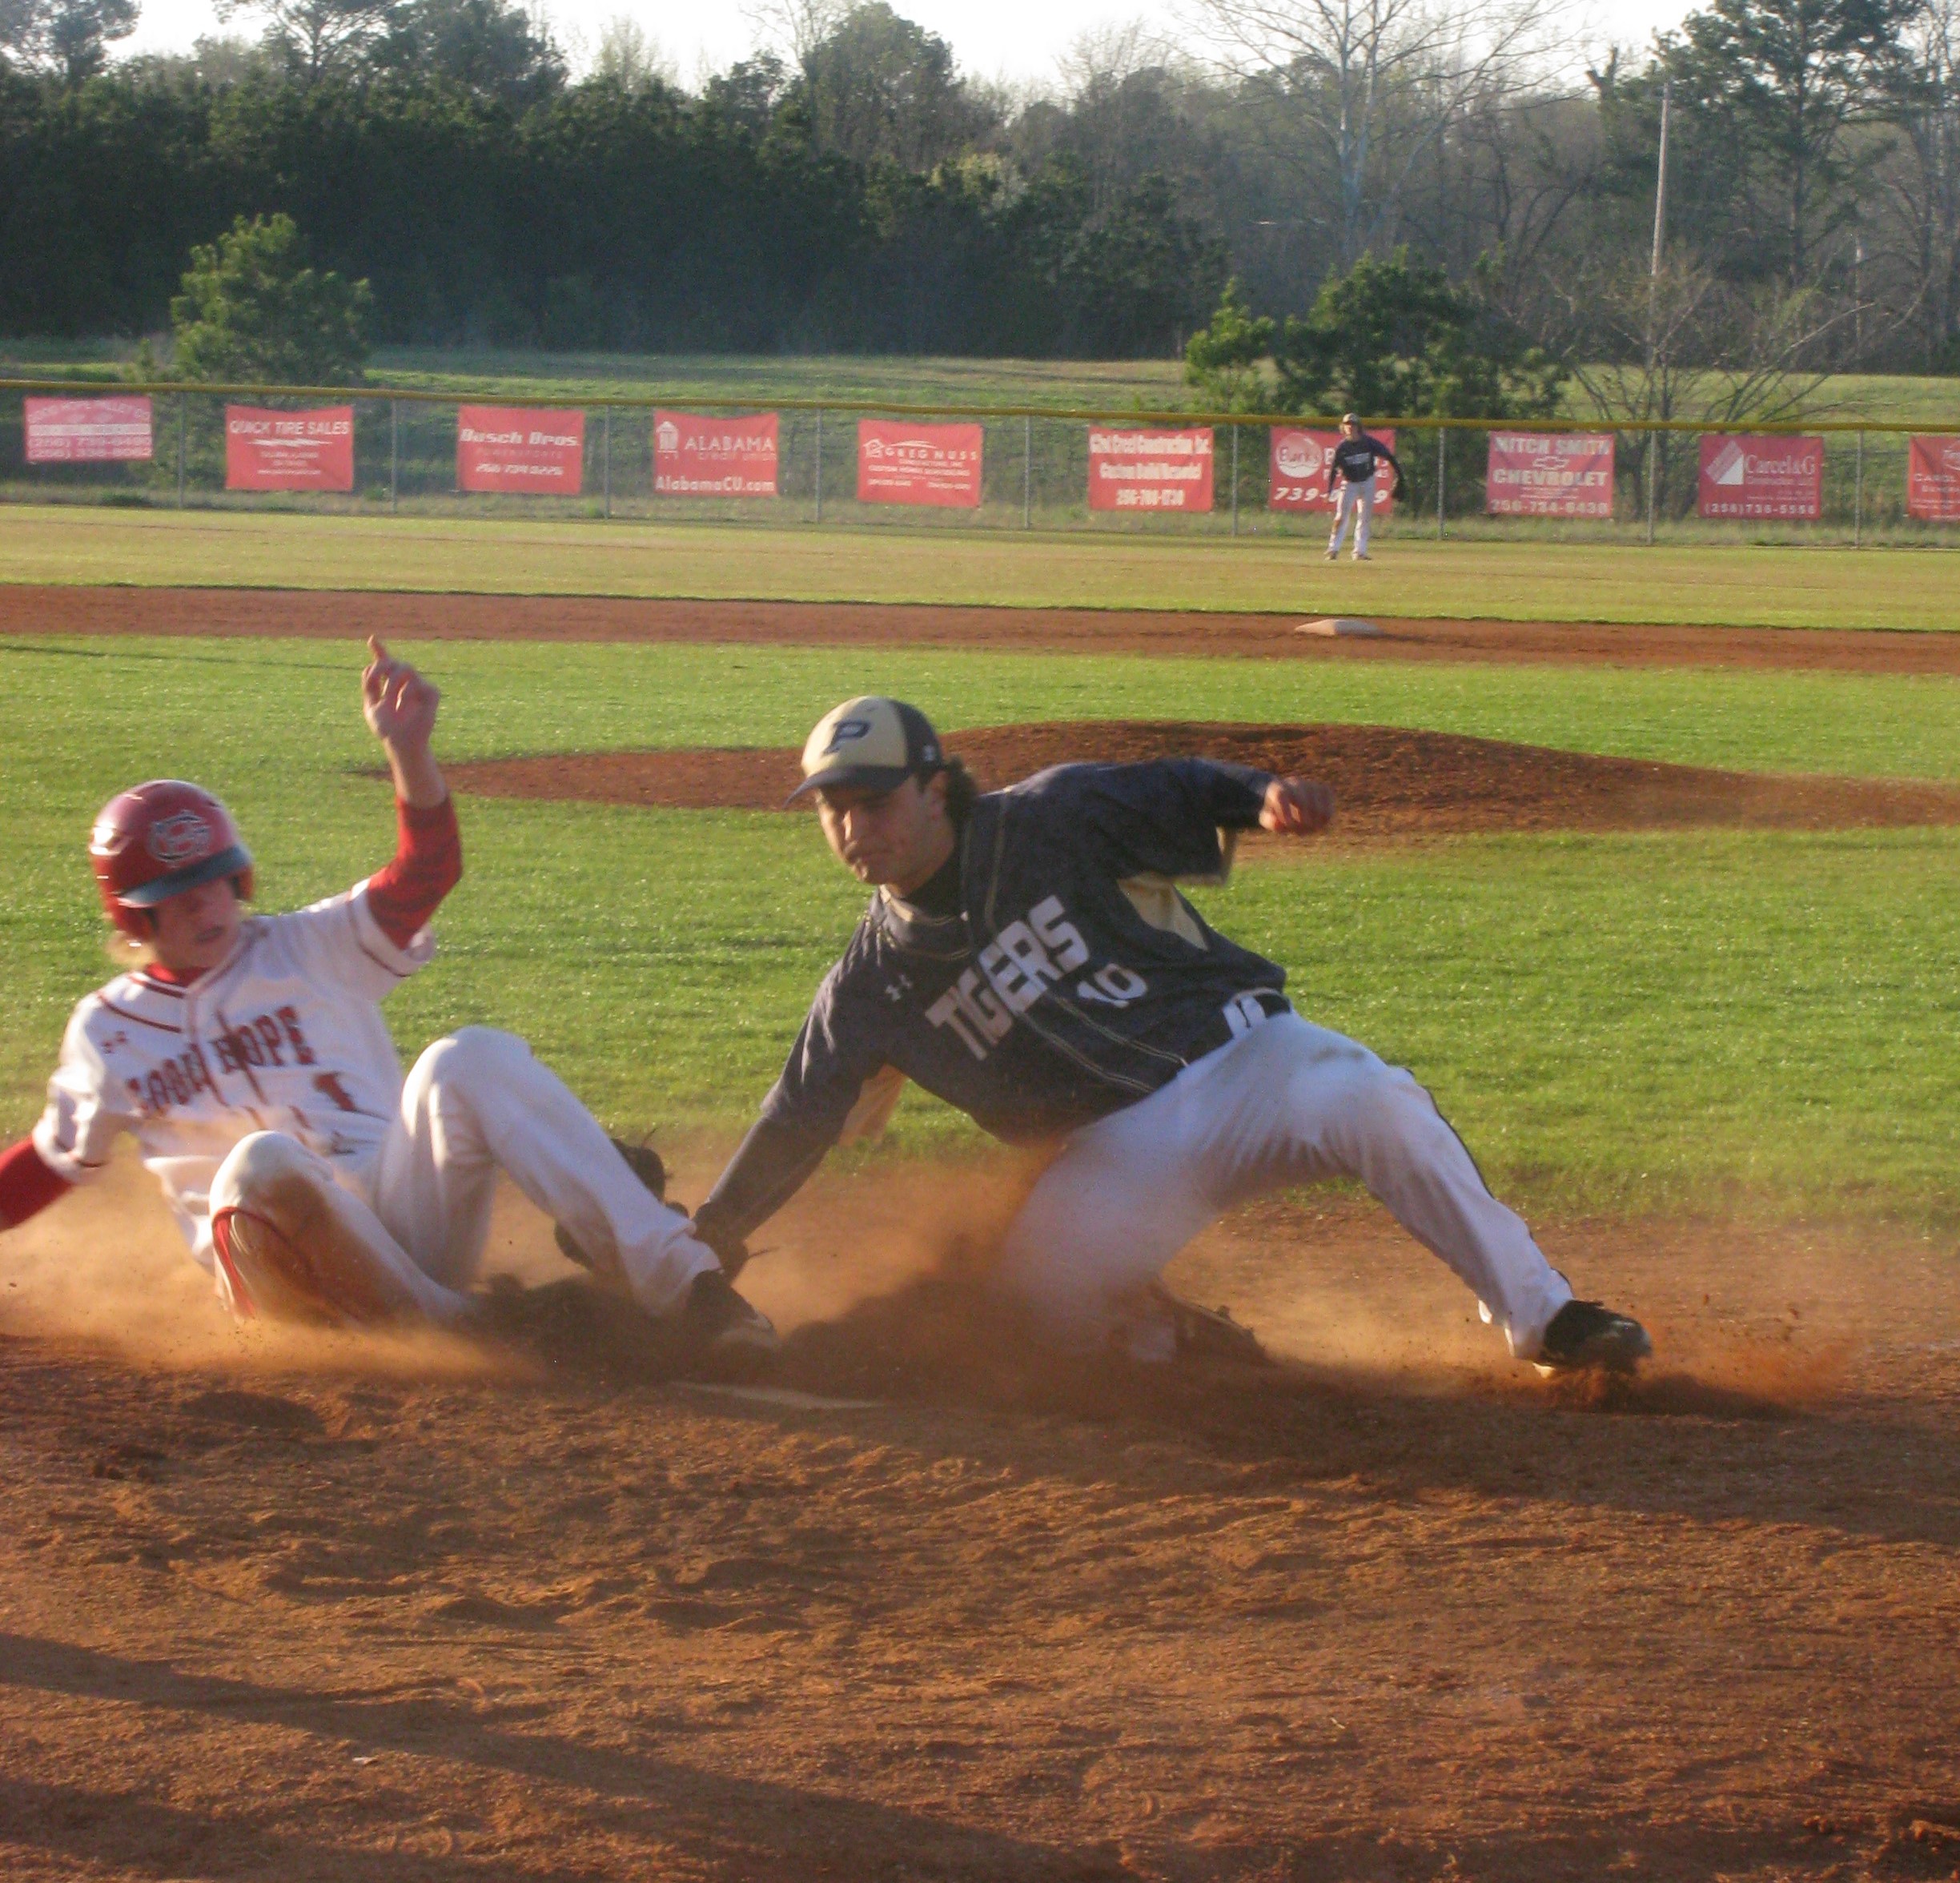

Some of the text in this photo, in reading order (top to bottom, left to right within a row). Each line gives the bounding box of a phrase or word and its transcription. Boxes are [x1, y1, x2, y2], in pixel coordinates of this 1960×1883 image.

[230, 420, 350, 436] QUICK TIRE SALES
[460, 428, 524, 444] Busch
[685, 435, 775, 452] ALABAMA
[655, 474, 775, 492] AlabamaCU.com
[1492, 468, 1609, 488] CHEVROLET
[823, 720, 871, 755] P
[925, 894, 1090, 1062] TIGERS
[1077, 962, 1149, 1009] 10
